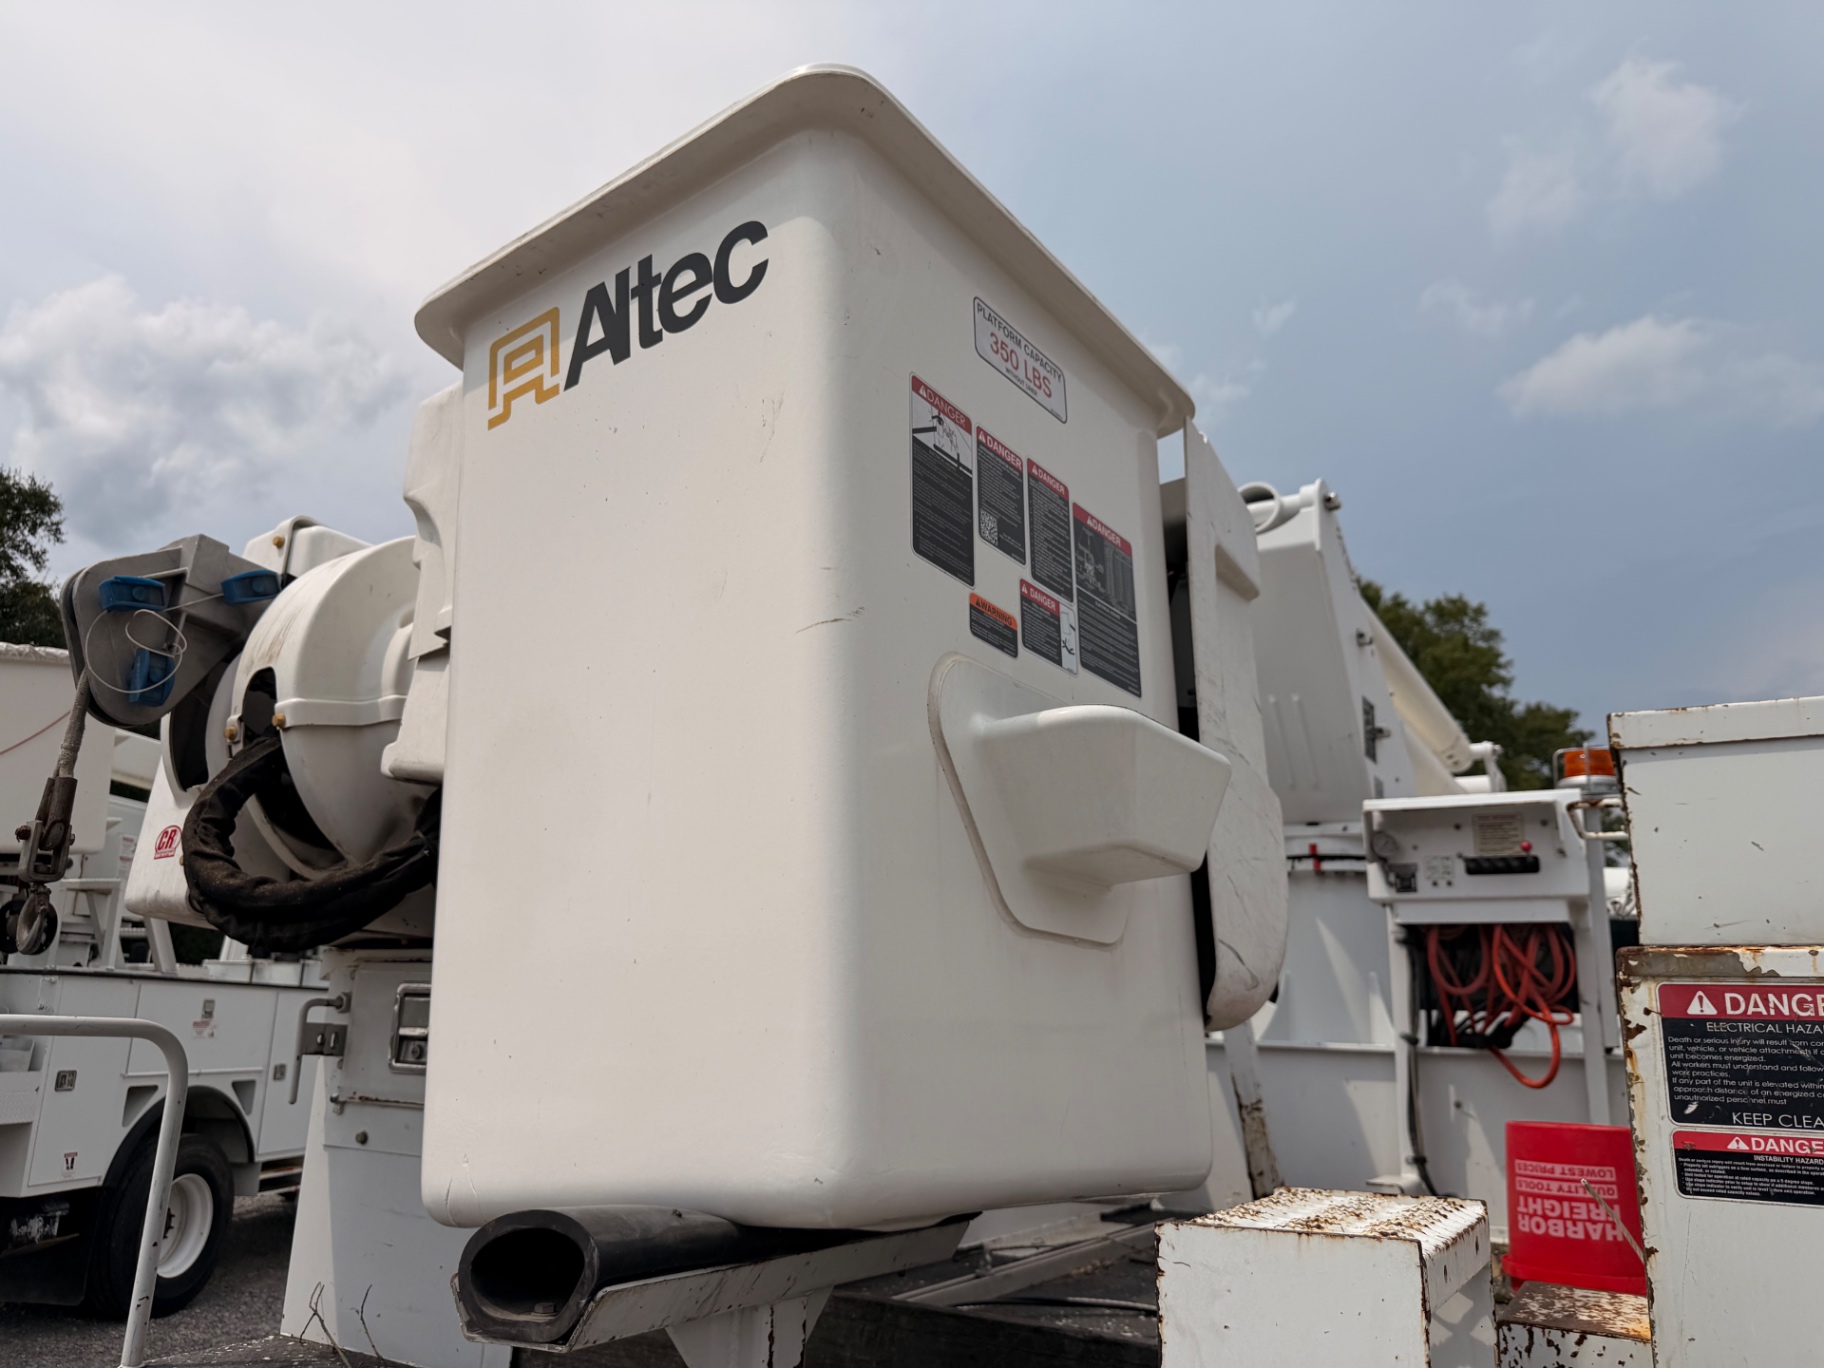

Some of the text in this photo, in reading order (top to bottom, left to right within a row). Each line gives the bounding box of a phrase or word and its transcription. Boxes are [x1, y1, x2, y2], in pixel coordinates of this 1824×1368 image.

[563, 220, 770, 392] Altec
[976, 302, 1062, 383] PLATFORM CAPACITY
[990, 331, 1052, 399] 350 LBS
[926, 388, 966, 428] DANGER
[986, 435, 1022, 472] DANGER
[1037, 468, 1065, 495] DANGER
[1092, 518, 1121, 548] DANGER
[1029, 587, 1056, 611] DANGER
[157, 829, 177, 850] CR
[1706, 1022, 1824, 1035] ELECTRICAL HAZA
[1668, 1035, 1692, 1043] Death
[1728, 1046, 1757, 1054] vehicle
[1723, 1055, 1767, 1063] energized.
[1732, 1063, 1779, 1071] understand
[1678, 1078, 1693, 1086] any
[1673, 1094, 1725, 1102] unauthorized
[1773, 1089, 1815, 1098] energized
[1732, 1112, 1773, 1126] KEEP
[1753, 1154, 1794, 1163] INSTABILITY
[1517, 1163, 1614, 1178] LOWEST PRICES
[1518, 1179, 1550, 1190] TOOLS
[1517, 1196, 1621, 1221] FREIGHT
[1518, 1214, 1623, 1241] HARBOR
